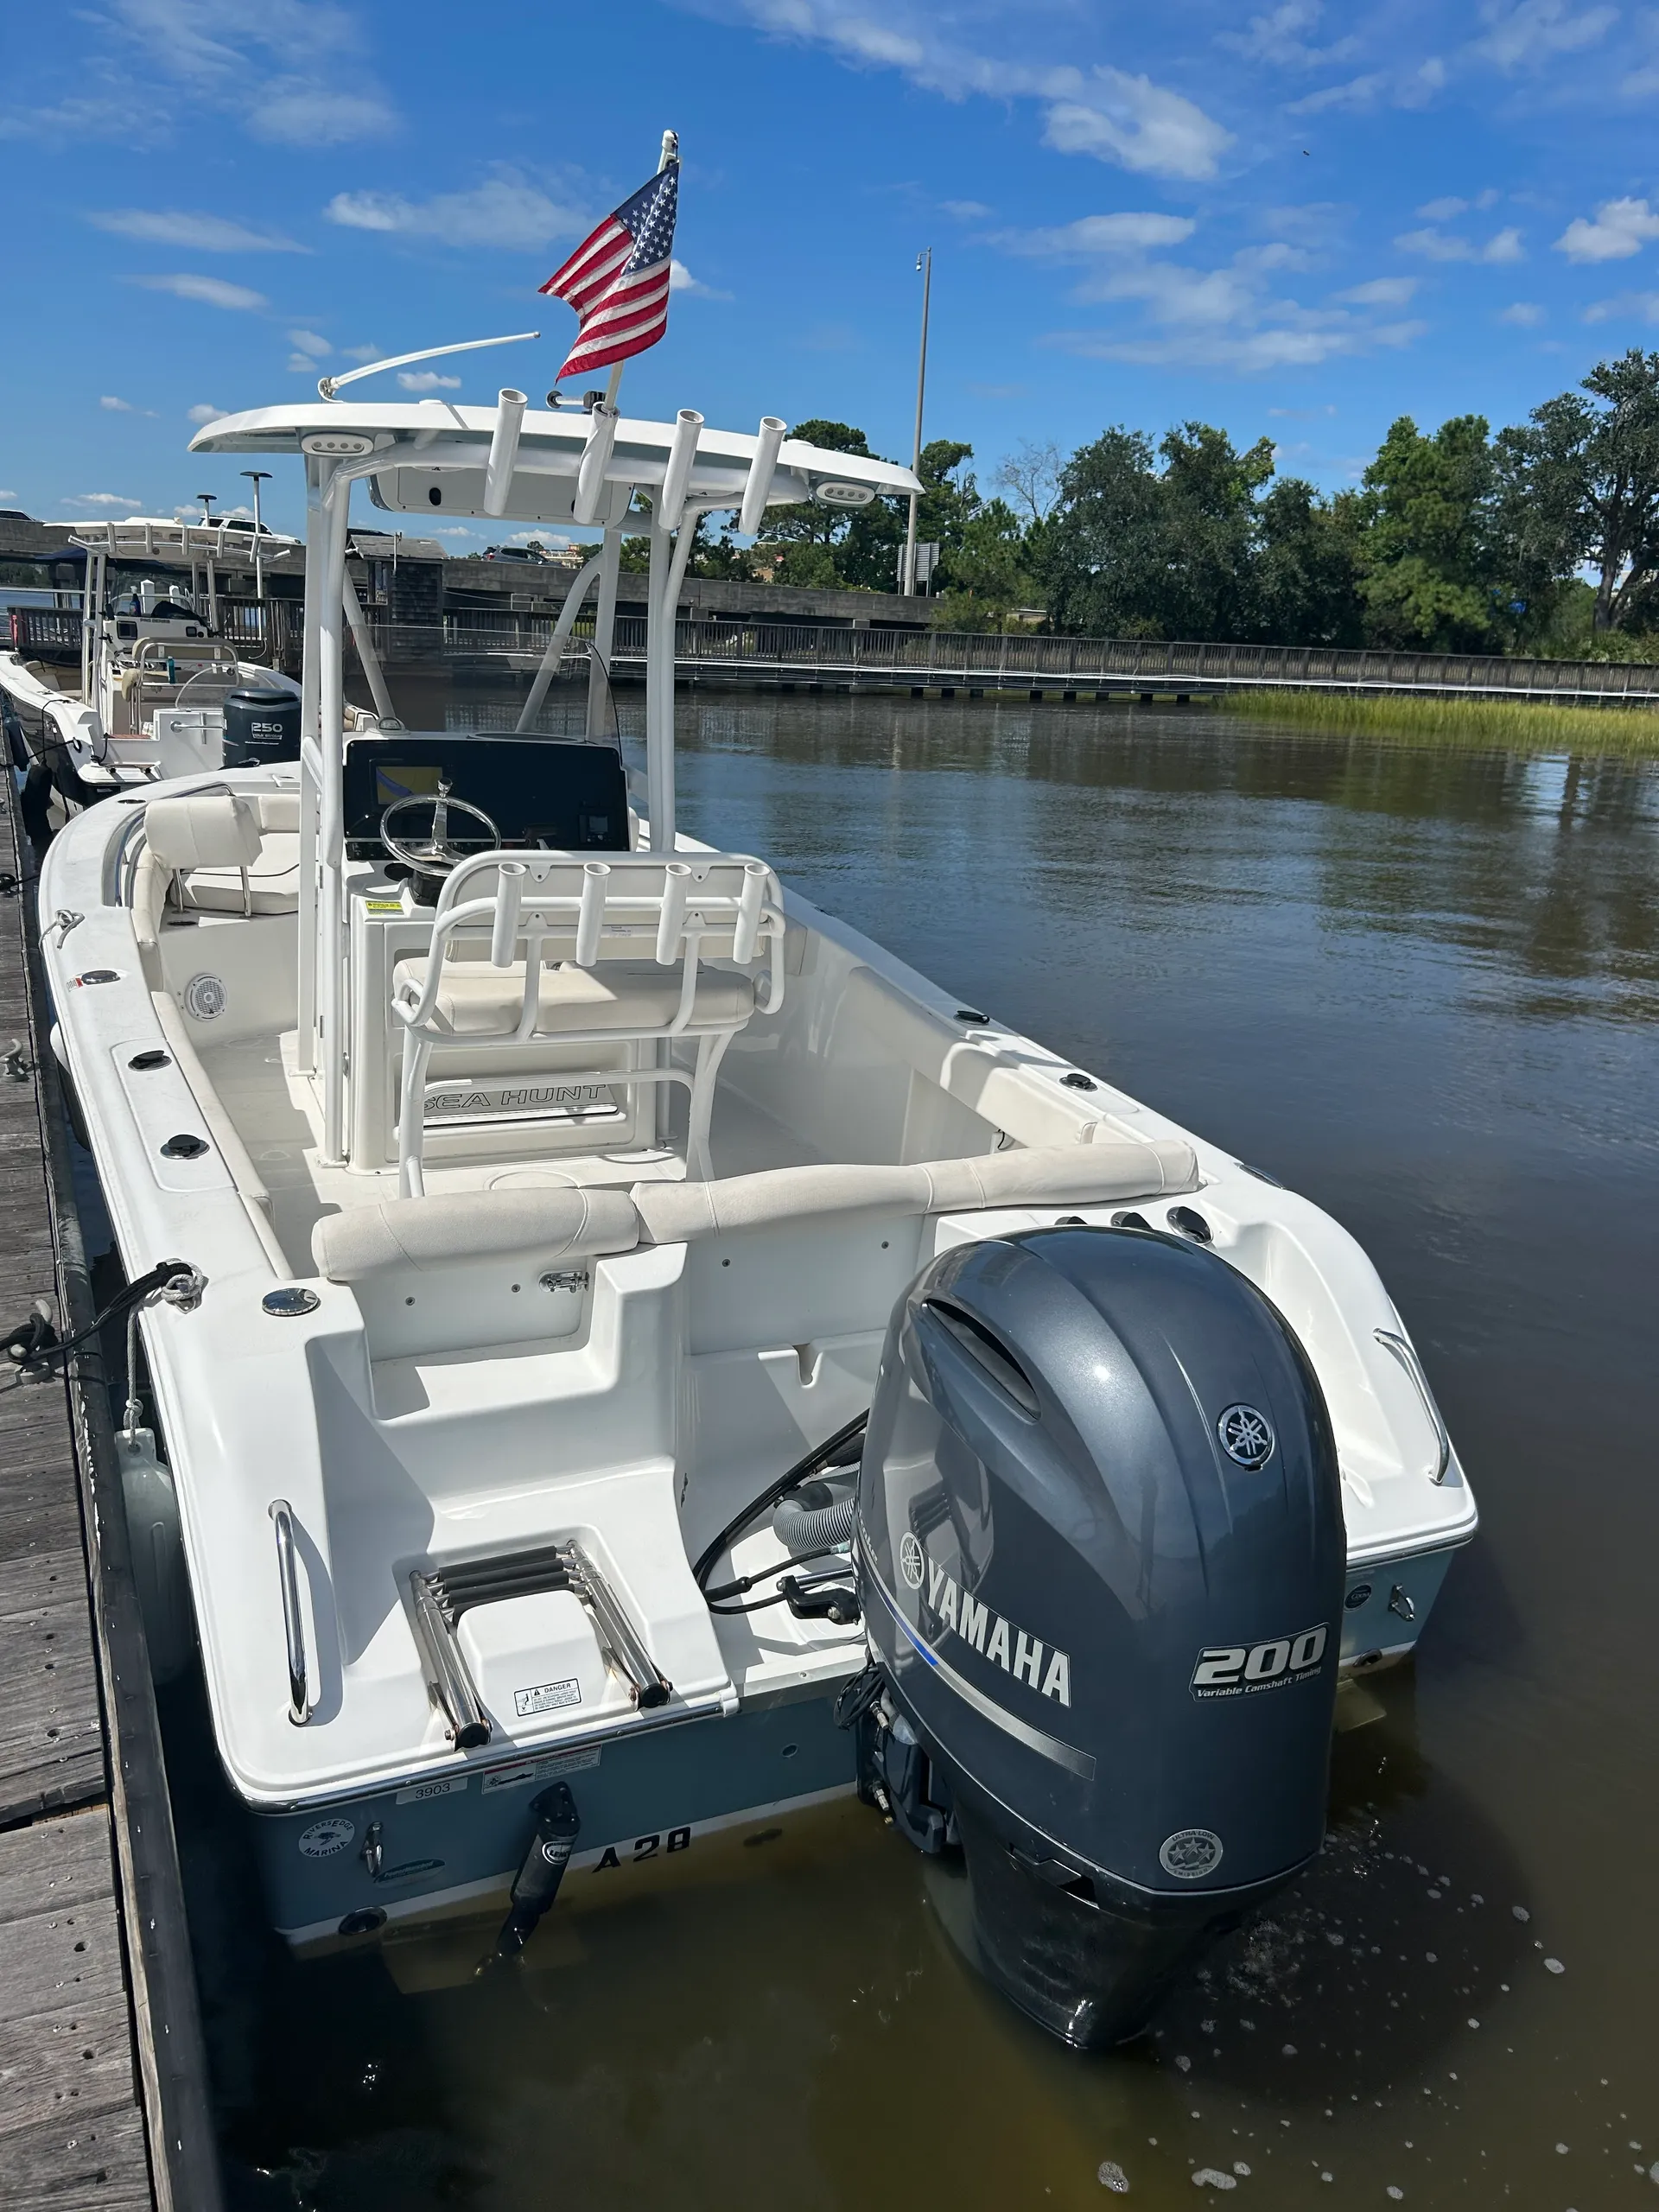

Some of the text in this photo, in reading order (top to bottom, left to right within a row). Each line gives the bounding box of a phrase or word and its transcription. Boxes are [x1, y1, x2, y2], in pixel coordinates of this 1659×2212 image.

[253, 722, 283, 733] 250
[500, 1084, 607, 1106] HUNT
[927, 1556, 1071, 1707] YAMAHA
[1192, 1627, 1327, 1685] 200
[543, 1682, 571, 1694] DANGER
[1197, 1666, 1322, 1697] Variable Camshaft Timing
[415, 1783, 450, 1799] 3903
[1172, 1831, 1215, 1841] ULTRA LOW
[303, 1840, 348, 1857] MARINA
